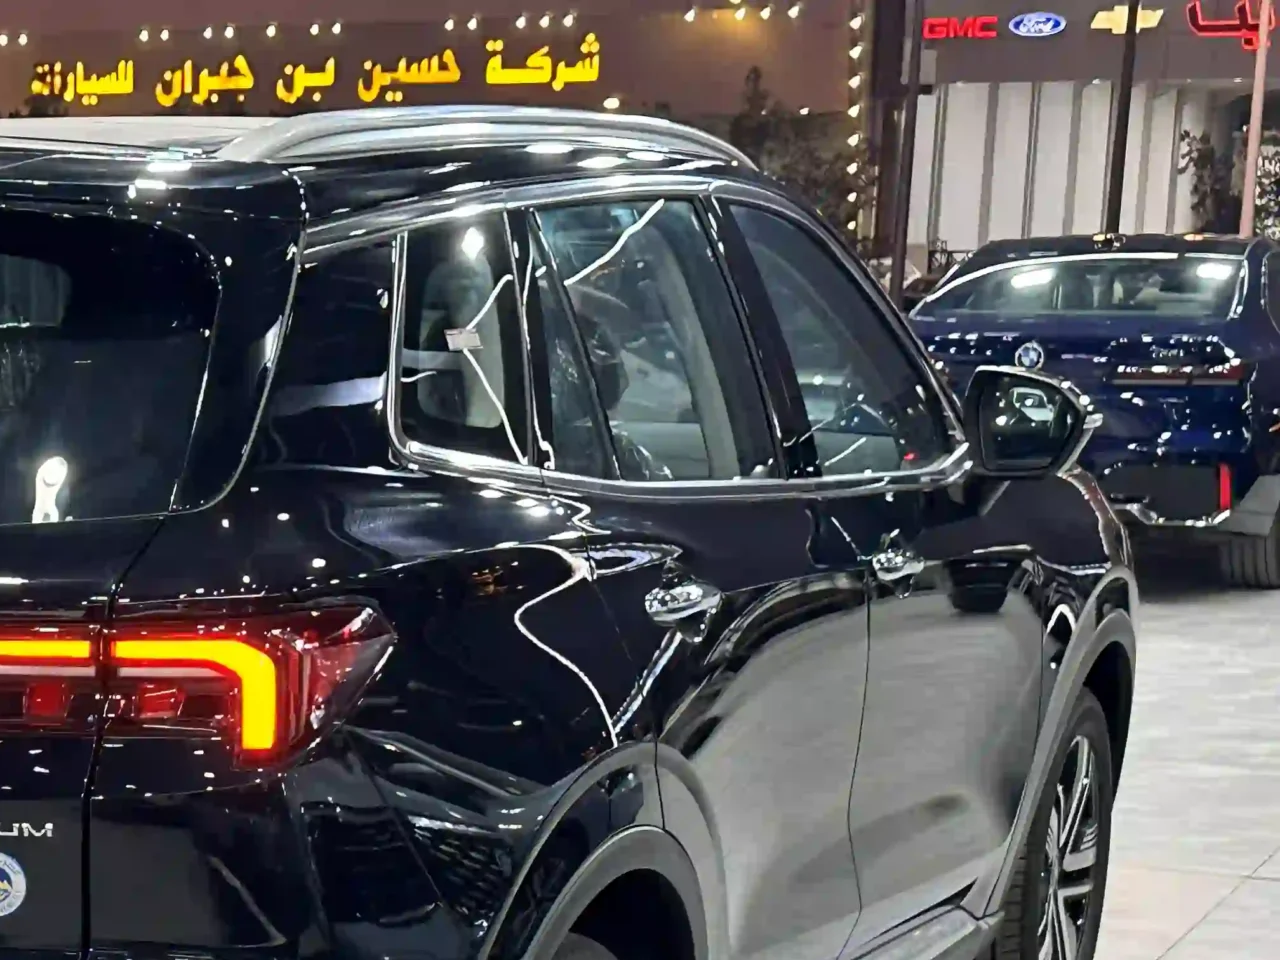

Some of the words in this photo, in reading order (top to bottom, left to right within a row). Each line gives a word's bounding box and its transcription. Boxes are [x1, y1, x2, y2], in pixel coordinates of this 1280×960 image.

[923, 16, 997, 39] GMC
[31, 59, 134, 106] للسيارات
[155, 54, 254, 107] جبران
[276, 56, 336, 104] بن
[357, 48, 461, 102] حسين
[486, 32, 600, 91] شركة
